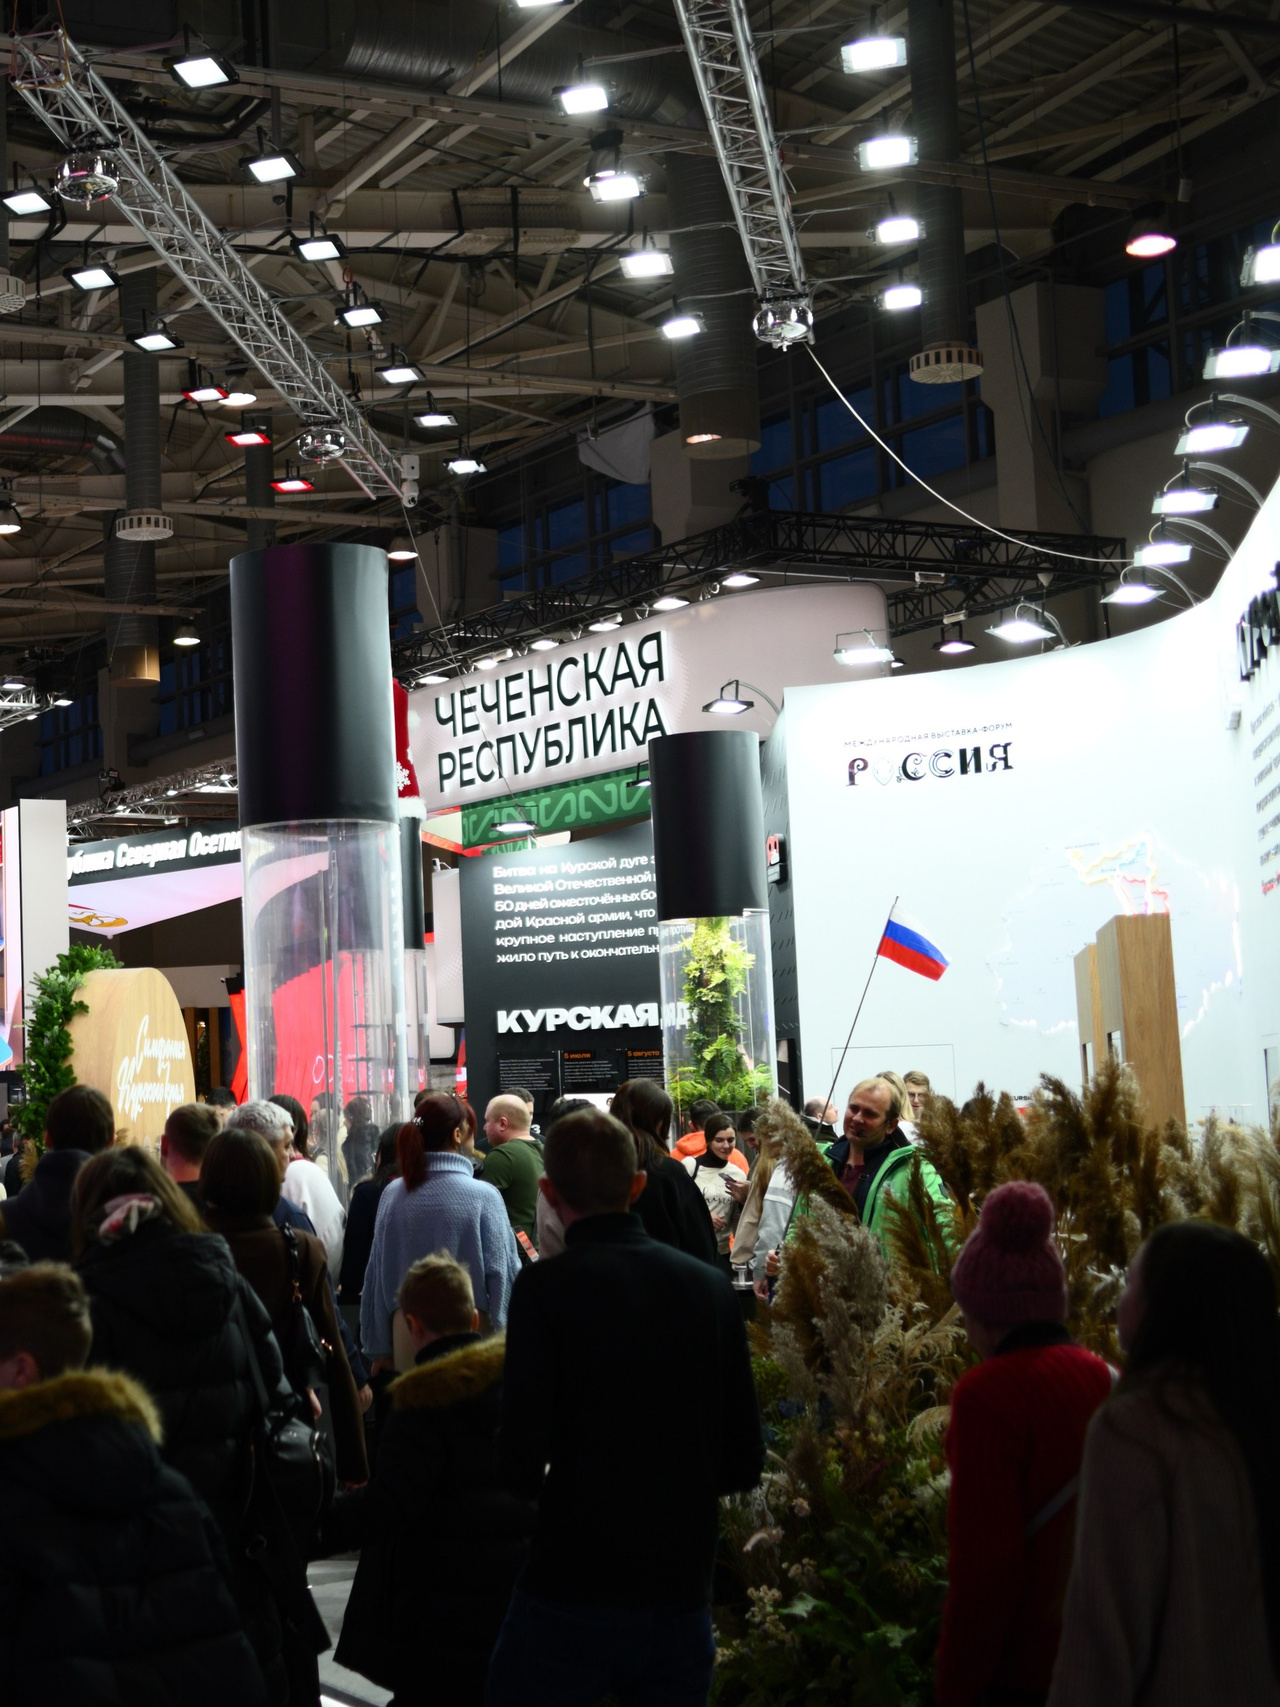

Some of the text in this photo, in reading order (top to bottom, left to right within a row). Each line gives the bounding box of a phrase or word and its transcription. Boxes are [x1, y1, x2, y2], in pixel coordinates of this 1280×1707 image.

[434, 631, 665, 738] ЧЕЧЕНСКАЯ
[437, 698, 668, 793] РЕСПУБЛИКА
[844, 722, 1013, 747] МЕЖДУНАРОДНАЯ ВЫСТАВКА-ФОРУМ
[116, 839, 187, 867] Северная
[493, 854, 649, 878] Битва на Курской дуге
[493, 871, 652, 895] Великой Отечественной
[495, 900, 514, 912] 50
[515, 897, 548, 912] дней
[549, 891, 639, 908] ожесточённых
[495, 907, 656, 931] дой Красной армии, что
[496, 933, 556, 948] крупное
[559, 925, 645, 943] наступление
[497, 951, 536, 963] жило
[538, 950, 569, 963] путь
[570, 949, 579, 959] к
[497, 1002, 659, 1033] КУРСКАЯ
[569, 1052, 591, 1060] июля
[633, 1050, 660, 1058] августа
